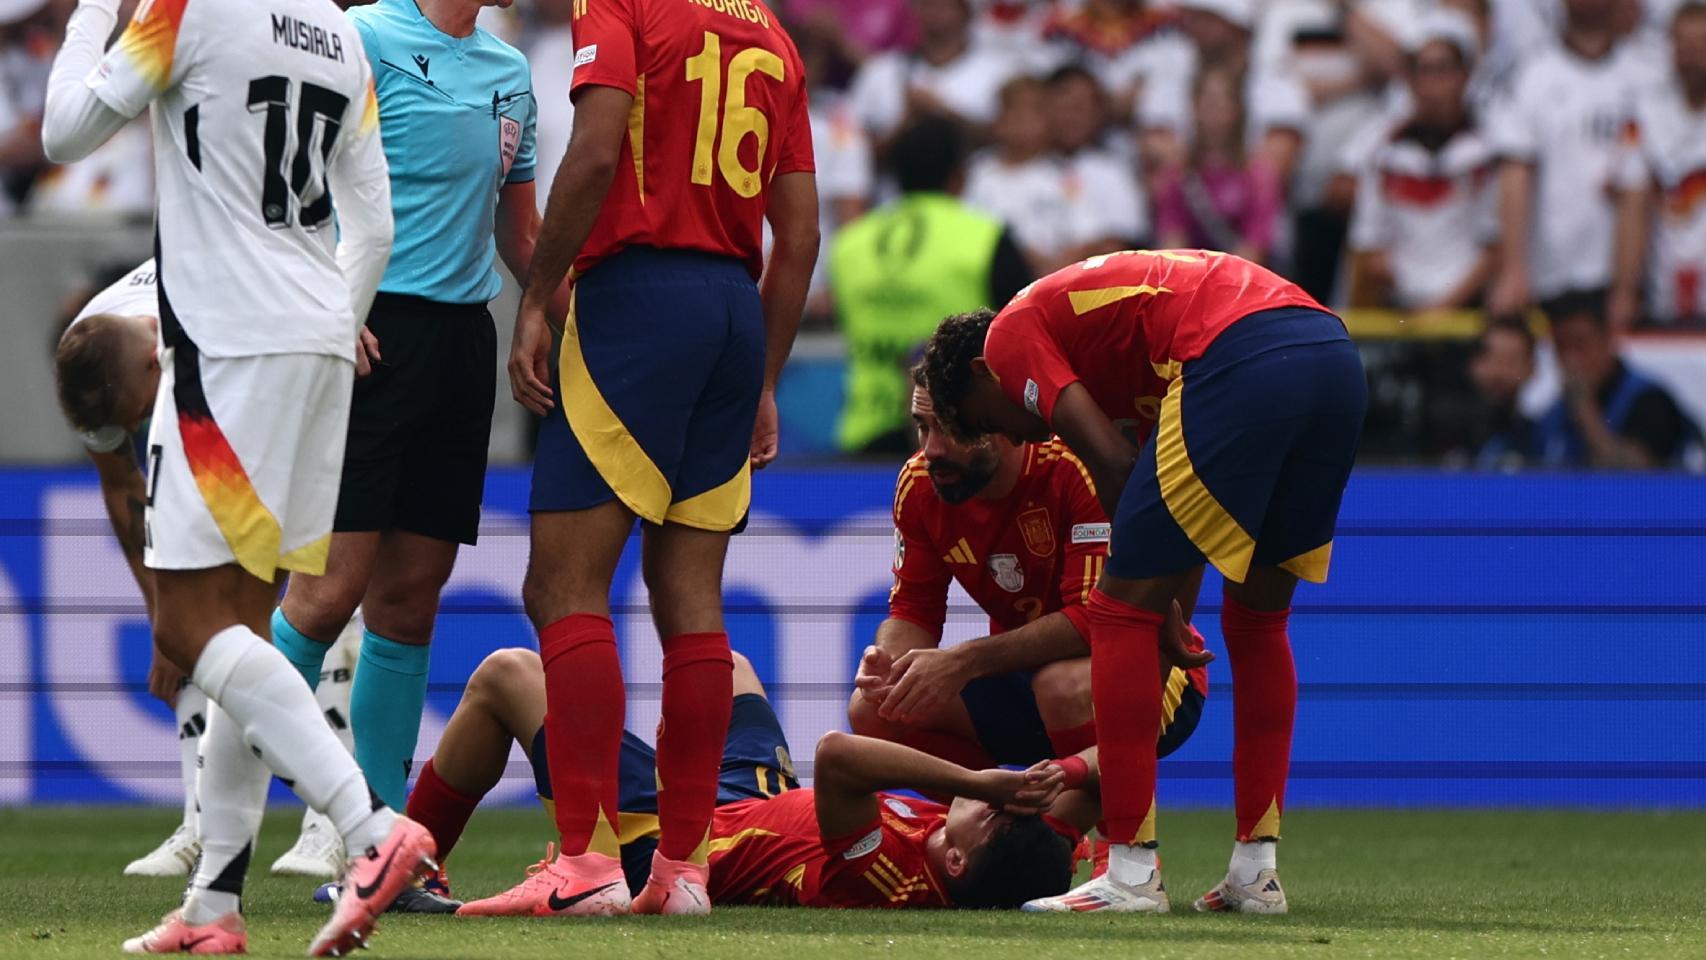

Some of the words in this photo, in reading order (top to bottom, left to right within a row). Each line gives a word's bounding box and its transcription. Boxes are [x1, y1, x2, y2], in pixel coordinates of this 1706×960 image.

[271, 13, 345, 64] MUSIALA
[688, 0, 770, 29] DRIGO
[247, 75, 350, 231] 10
[683, 31, 785, 198] 16
